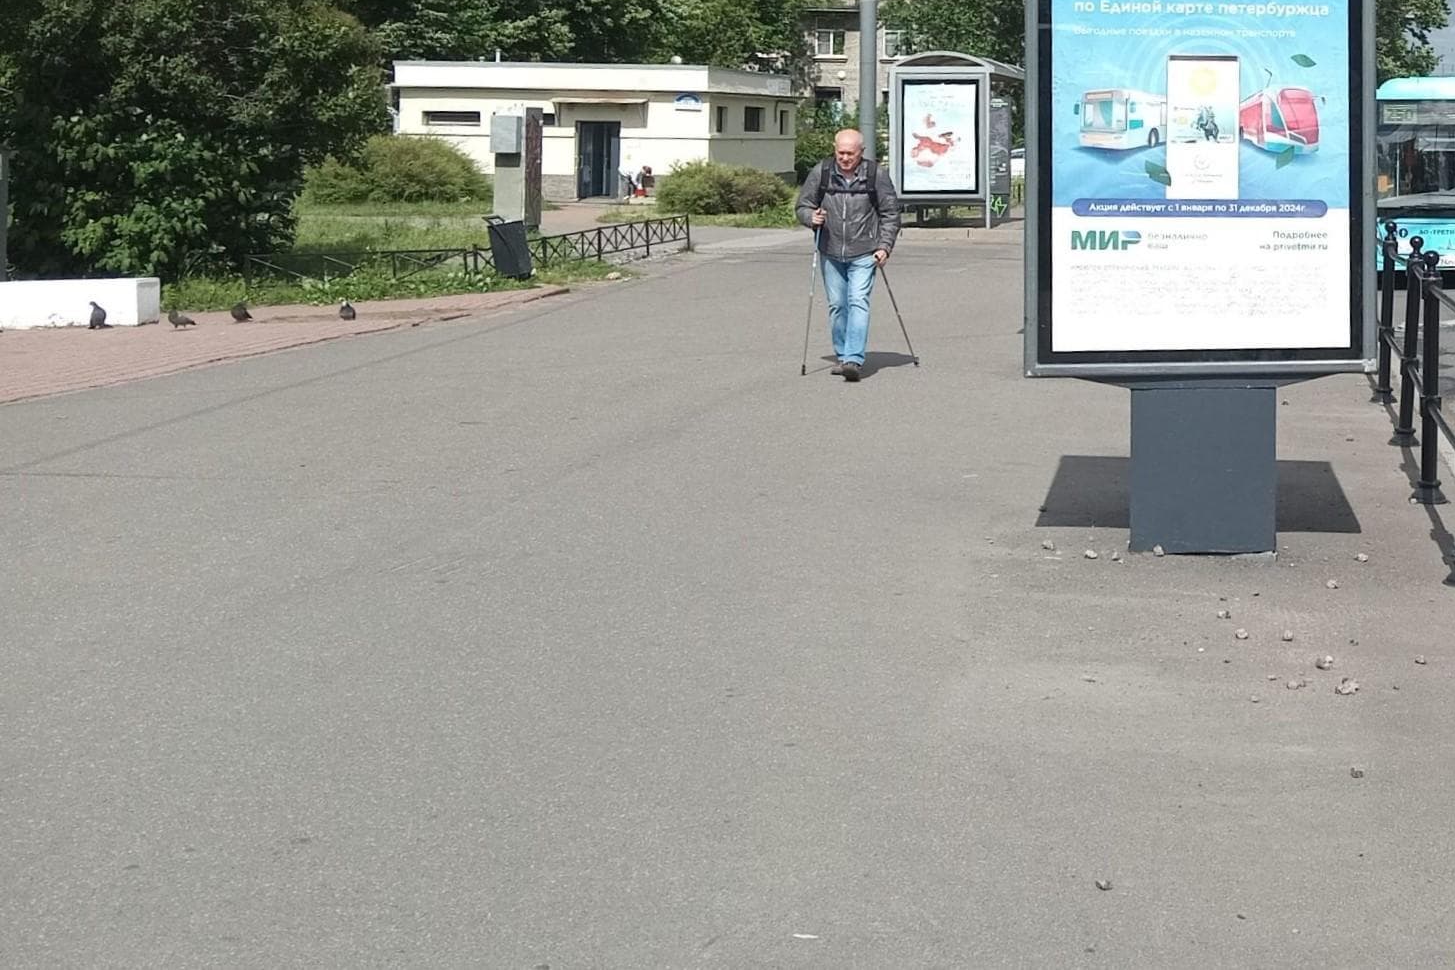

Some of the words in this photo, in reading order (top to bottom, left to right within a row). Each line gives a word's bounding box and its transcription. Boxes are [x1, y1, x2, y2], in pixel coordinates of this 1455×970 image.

[1074, 1, 1095, 12] по
[1100, 0, 1163, 14] Единой
[1166, 2, 1214, 16] карте
[1218, 1, 1329, 17] петербуржца
[1237, 29, 1297, 39] транспорте
[1089, 203, 1119, 213] Акция
[1120, 203, 1166, 213] действует
[1167, 204, 1174, 212] с
[1175, 203, 1179, 212] 1
[1181, 204, 1213, 213] января
[1229, 204, 1238, 212] 31
[1239, 203, 1277, 214] декабря
[1071, 230, 1142, 250] МИР
[1272, 230, 1329, 241] Подробнее
